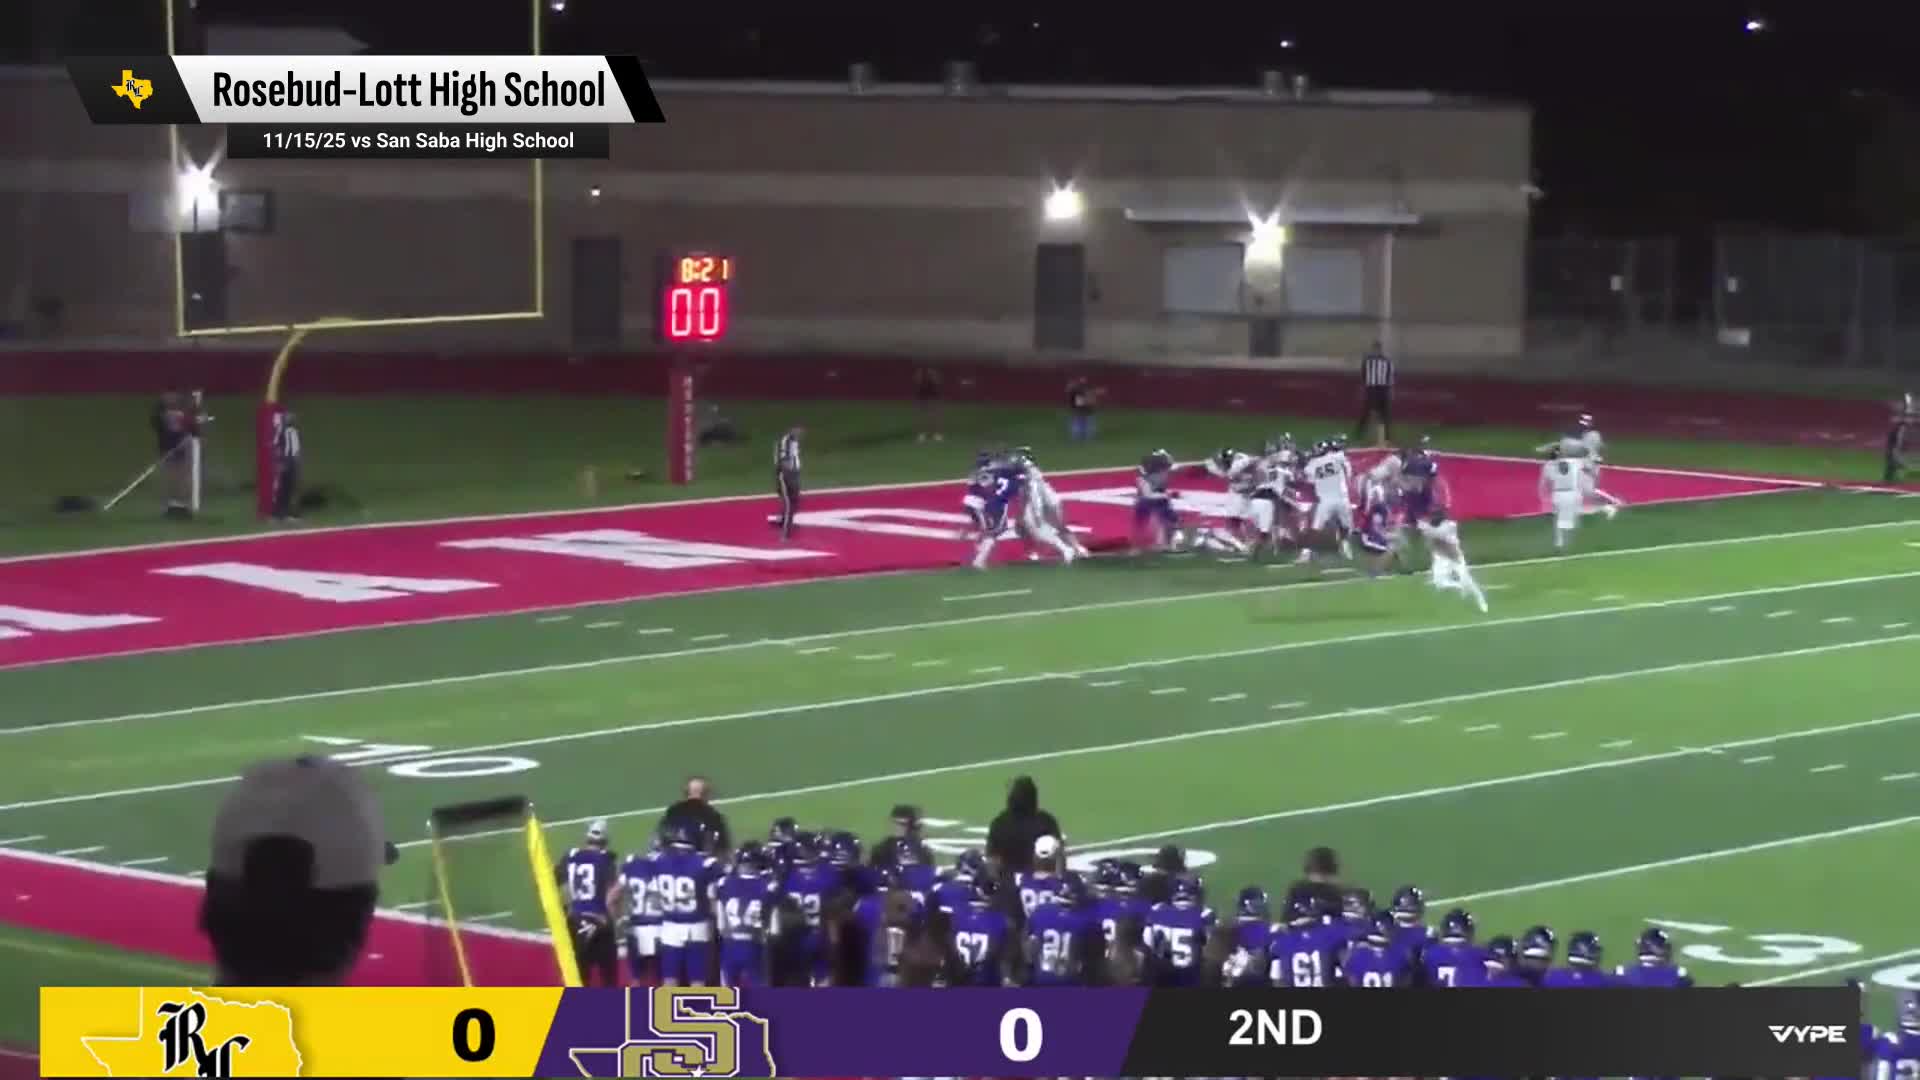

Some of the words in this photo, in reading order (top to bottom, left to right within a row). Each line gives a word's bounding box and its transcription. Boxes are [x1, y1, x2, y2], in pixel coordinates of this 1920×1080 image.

[681, 257, 729, 283] 8:21
[671, 288, 720, 336] 00
[568, 862, 596, 900] 13
[658, 874, 697, 912] 99
